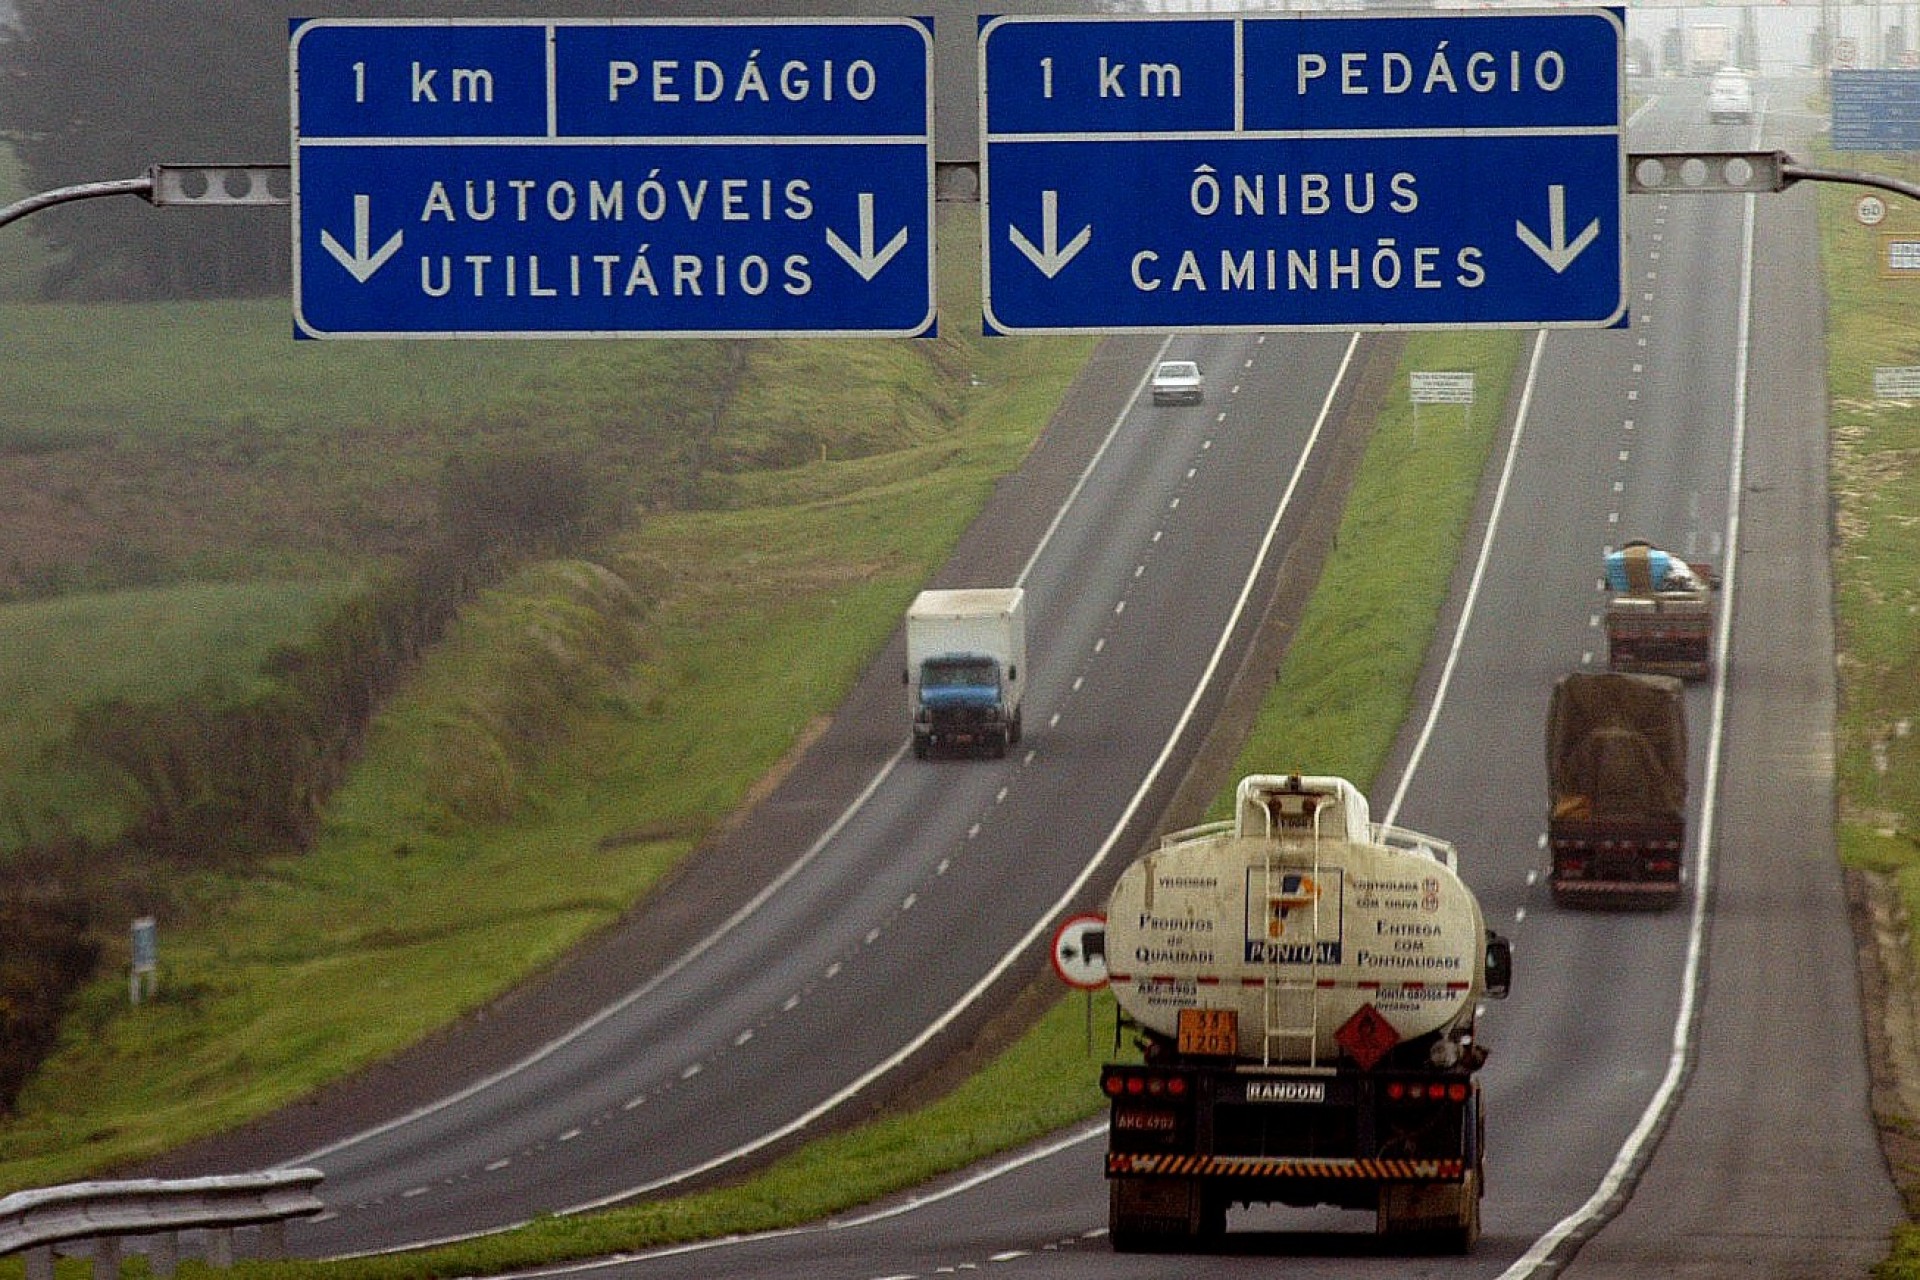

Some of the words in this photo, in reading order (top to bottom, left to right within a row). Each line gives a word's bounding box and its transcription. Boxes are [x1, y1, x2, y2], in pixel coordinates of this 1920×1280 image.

[352, 61, 364, 103] 1
[412, 61, 493, 103] km
[609, 49, 876, 102] PEDÁGIO
[1040, 57, 1052, 98] 1
[1099, 56, 1181, 98] km
[1297, 40, 1564, 95] PEDÁGIO
[421, 168, 813, 222] AUTOMÓVEIS
[1190, 163, 1418, 216] ÔNIBUS
[420, 244, 812, 297] UTILITÁRIOS
[1131, 238, 1485, 292] CAMINHÕES
[1251, 943, 1336, 962] PONTUAL
[1250, 1083, 1322, 1099] RANDON
